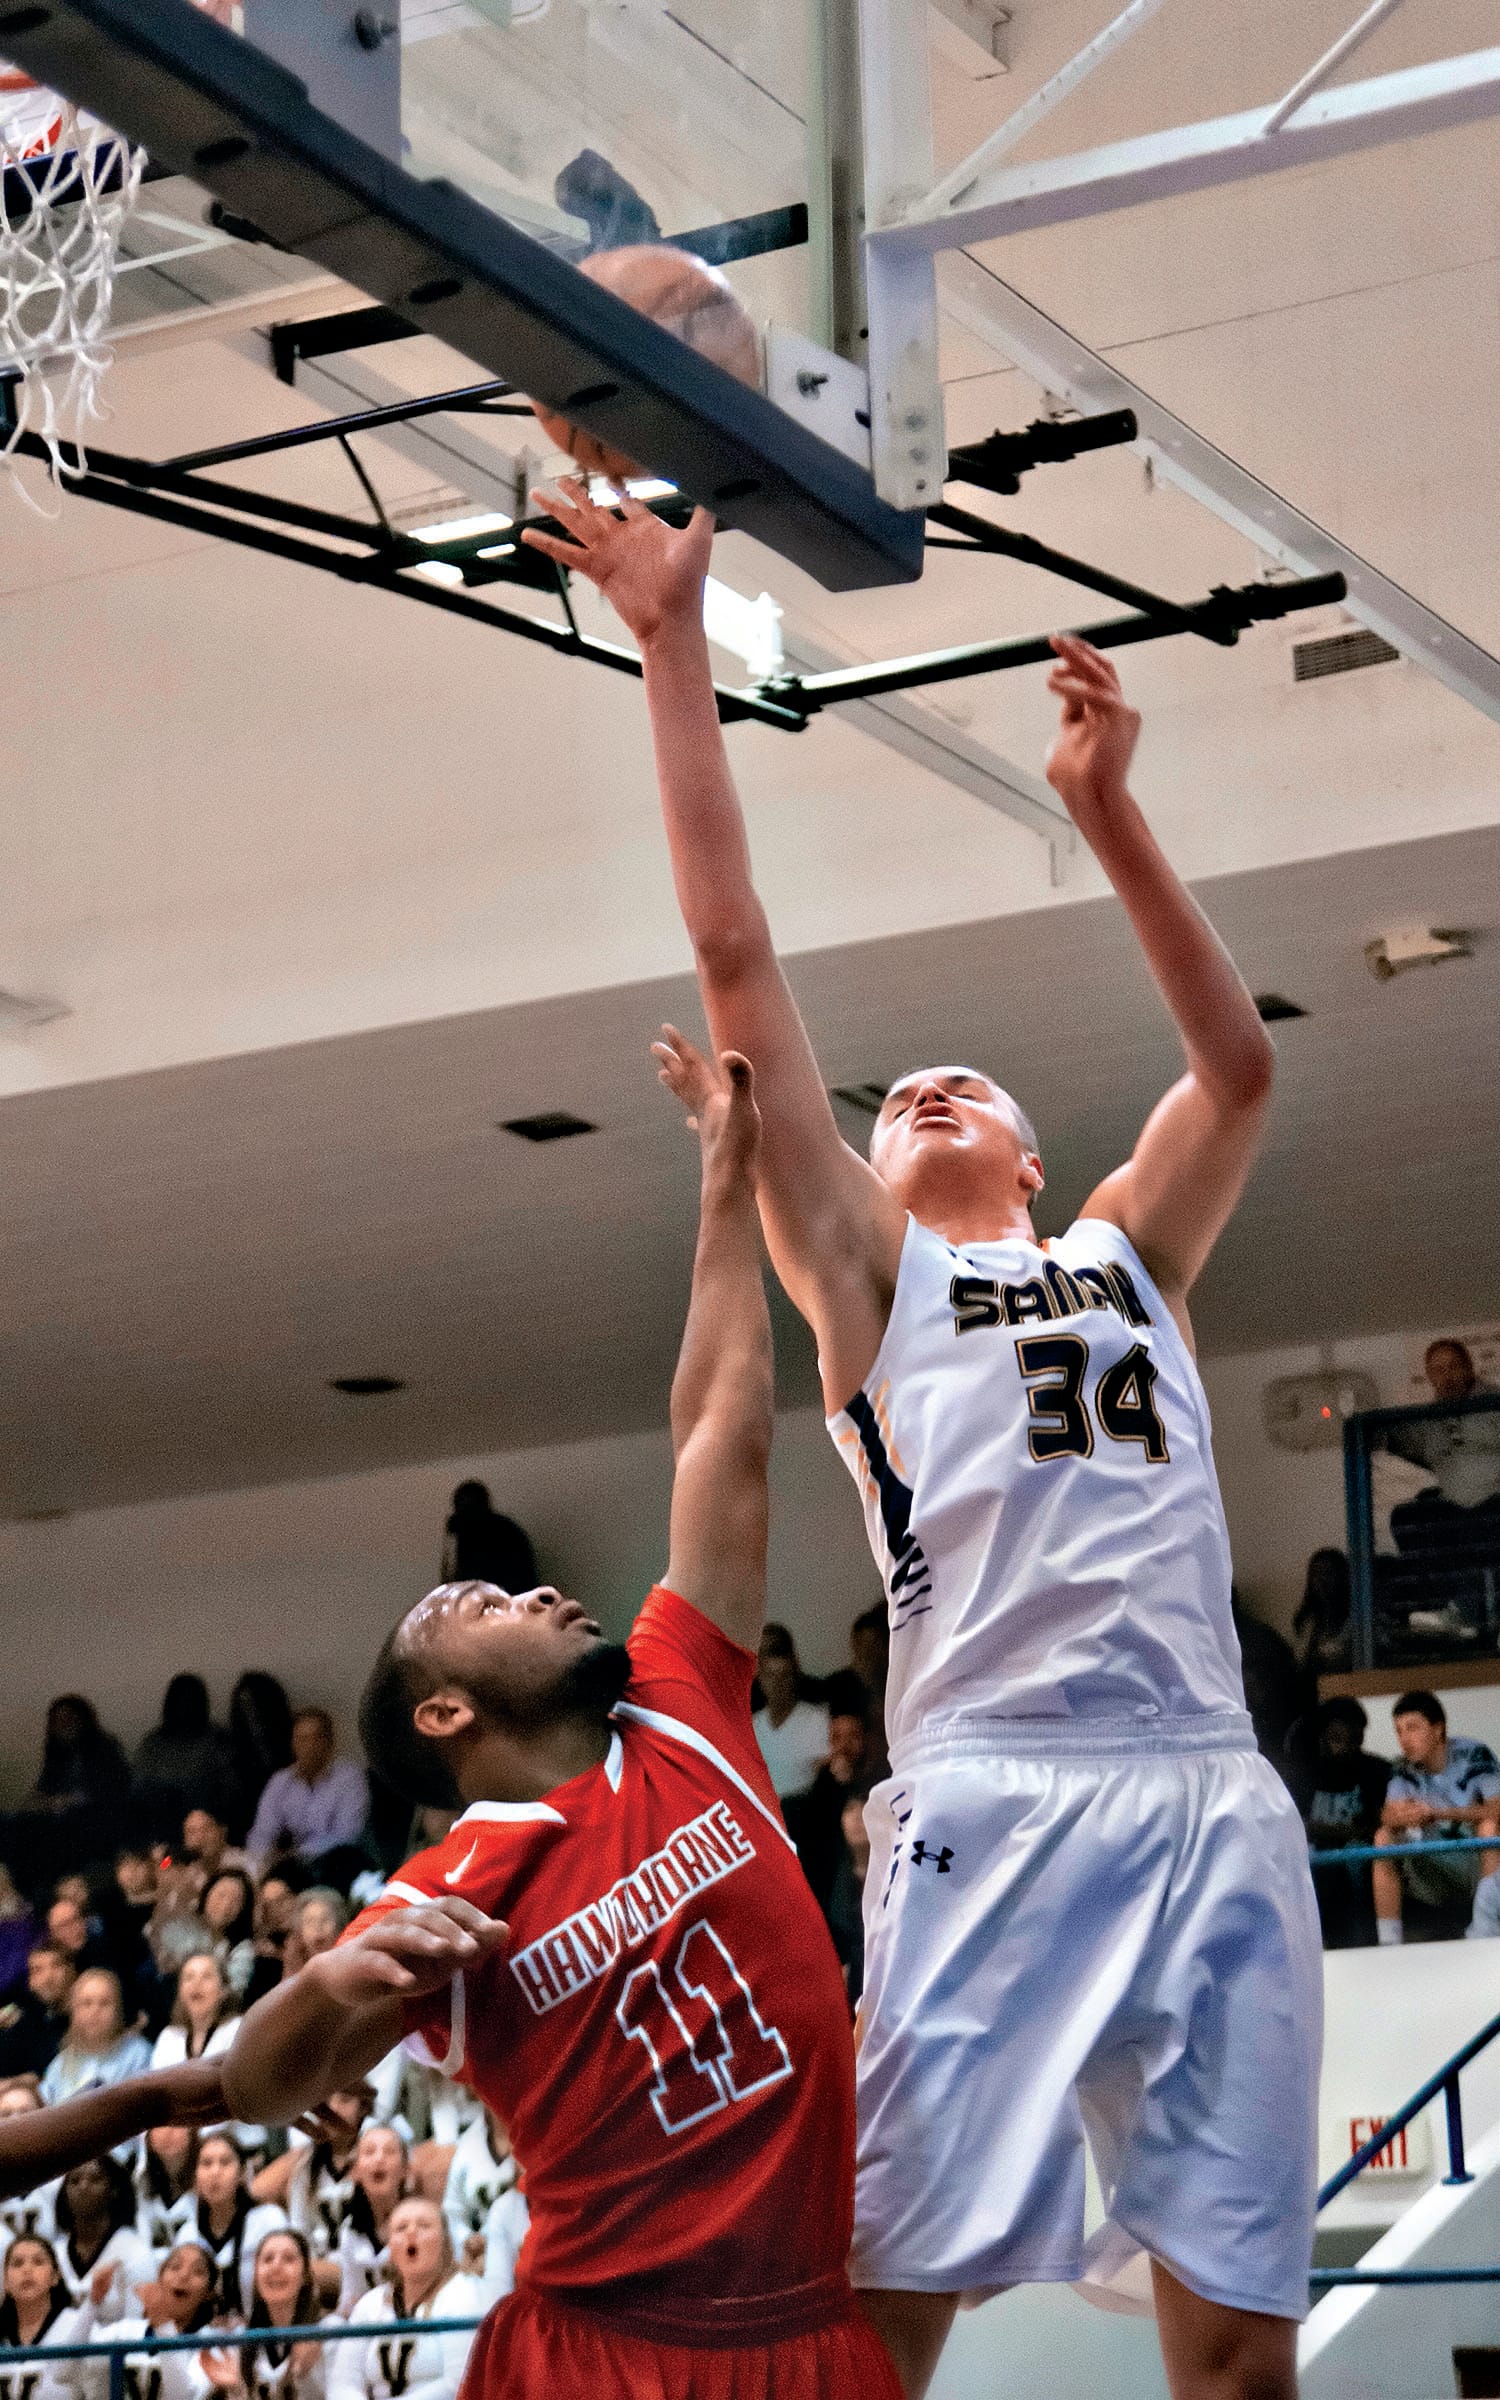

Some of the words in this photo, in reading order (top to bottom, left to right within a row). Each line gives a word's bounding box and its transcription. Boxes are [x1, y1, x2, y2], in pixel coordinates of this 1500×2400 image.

[1014, 1332, 1169, 1463] 34
[616, 1918, 794, 2136] 11
[377, 2339, 416, 2397] V
